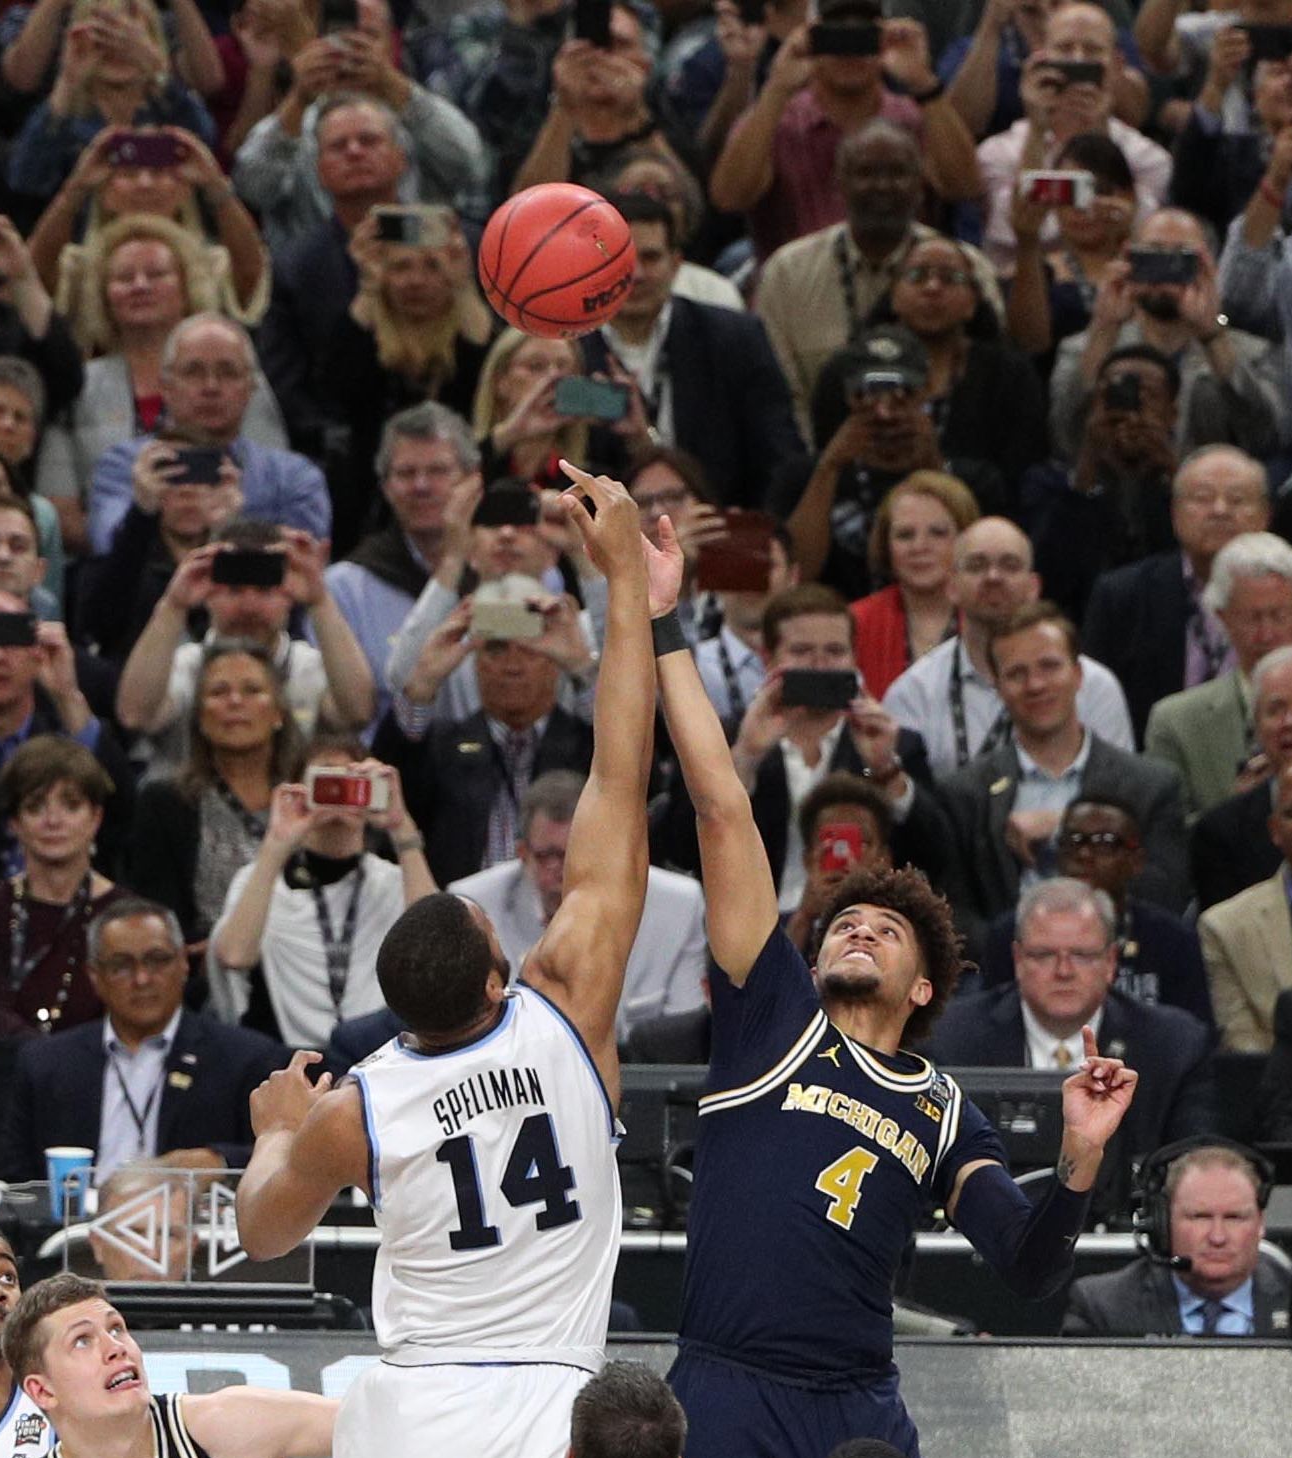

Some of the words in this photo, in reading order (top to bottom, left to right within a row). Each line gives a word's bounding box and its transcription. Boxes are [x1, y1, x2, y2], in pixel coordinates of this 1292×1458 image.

[432, 1066, 546, 1137] SPELLMAN
[781, 1082, 932, 1185] MICHIGAN
[435, 1112, 583, 1251] 14
[815, 1145, 880, 1231] 4
